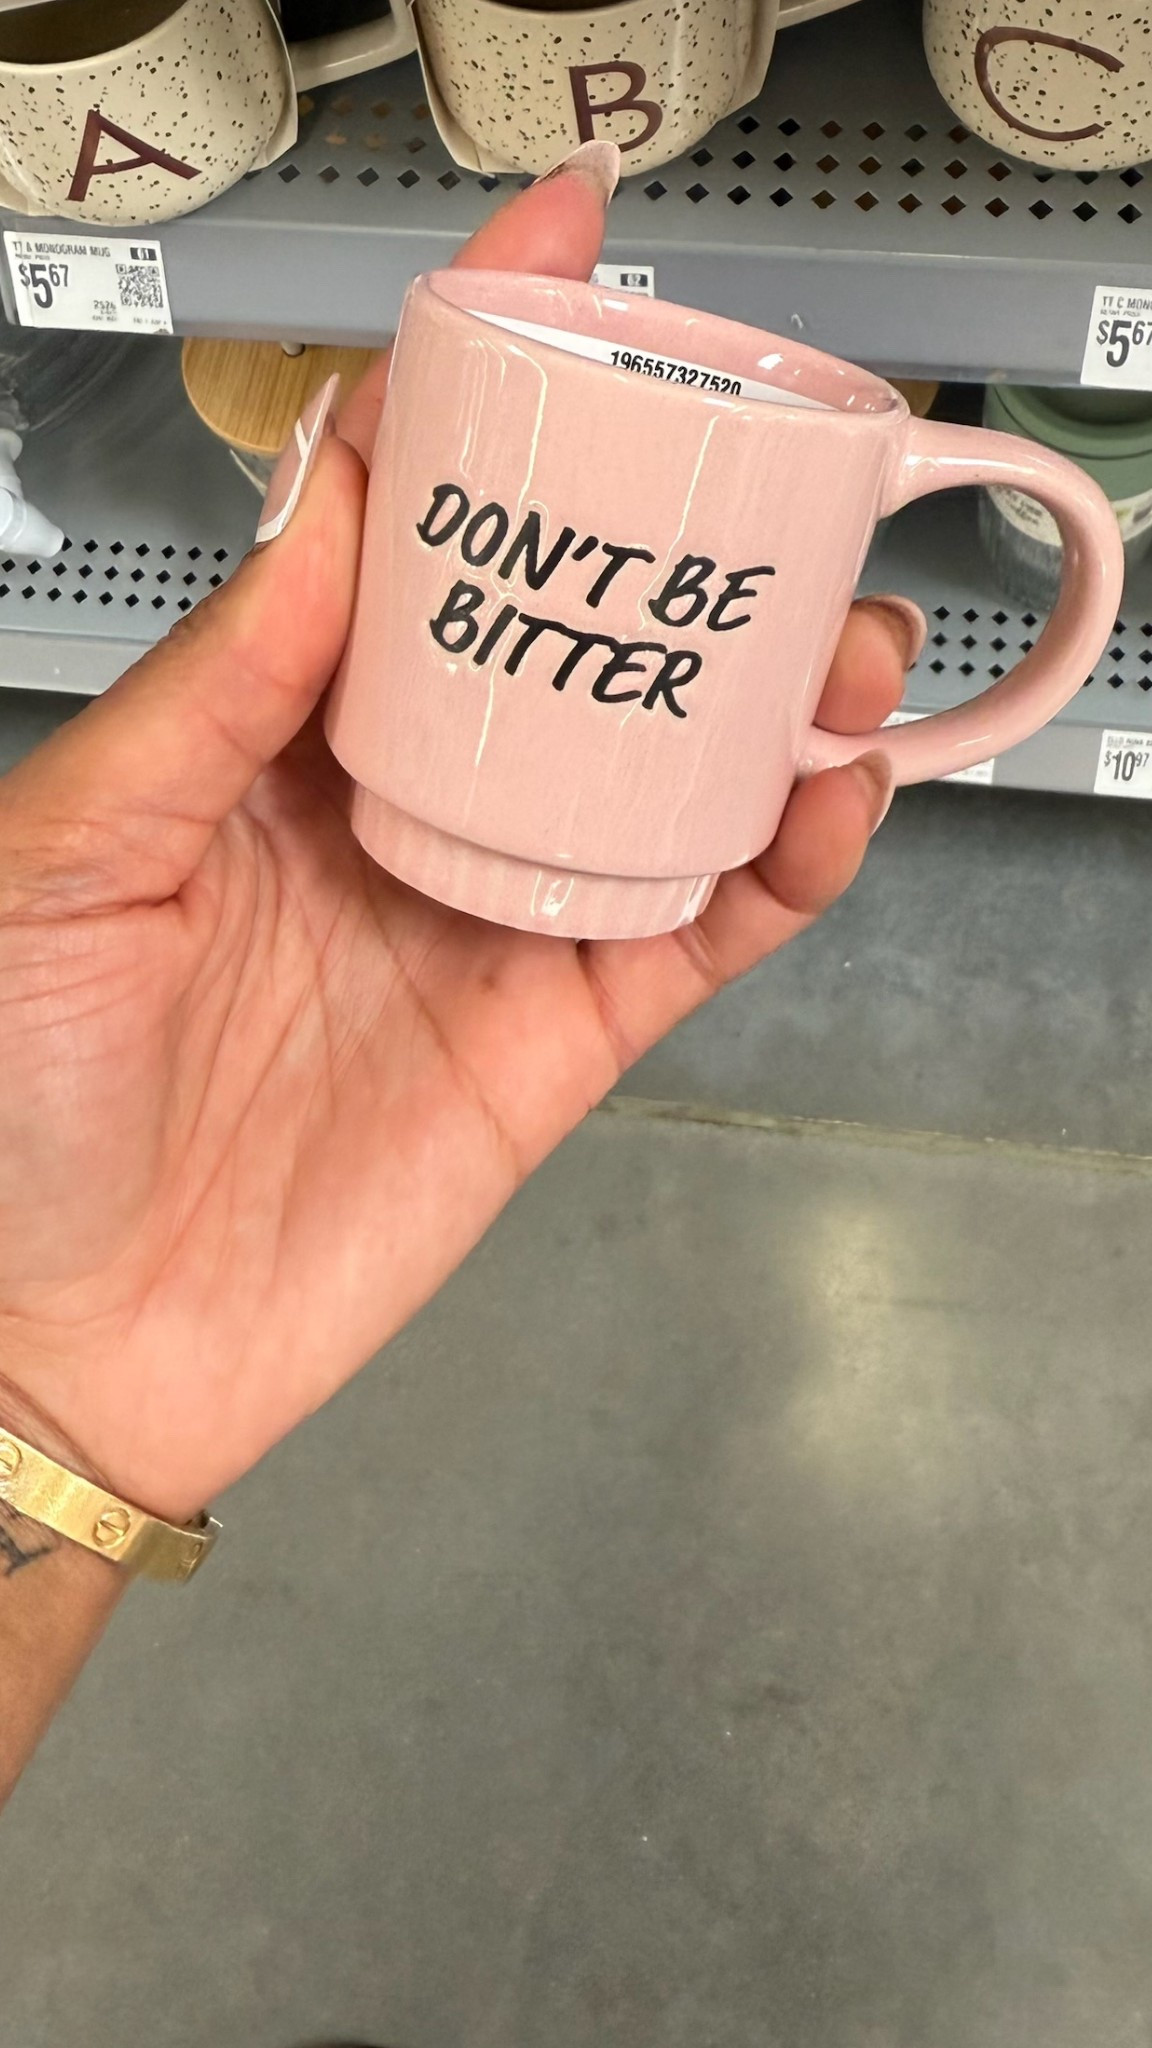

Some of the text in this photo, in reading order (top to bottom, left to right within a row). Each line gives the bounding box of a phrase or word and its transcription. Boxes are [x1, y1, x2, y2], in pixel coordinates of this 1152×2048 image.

[568, 60, 663, 153] B
[974, 26, 1125, 141] C
[66, 109, 202, 201] A
[35, 243, 87, 256] MONOGRAM
[90, 246, 111, 257] MUG
[1103, 296, 1152, 310] TT C MON
[611, 350, 742, 396] 196557327520
[416, 483, 776, 632] DON'T BE
[429, 579, 703, 718] BITTER
